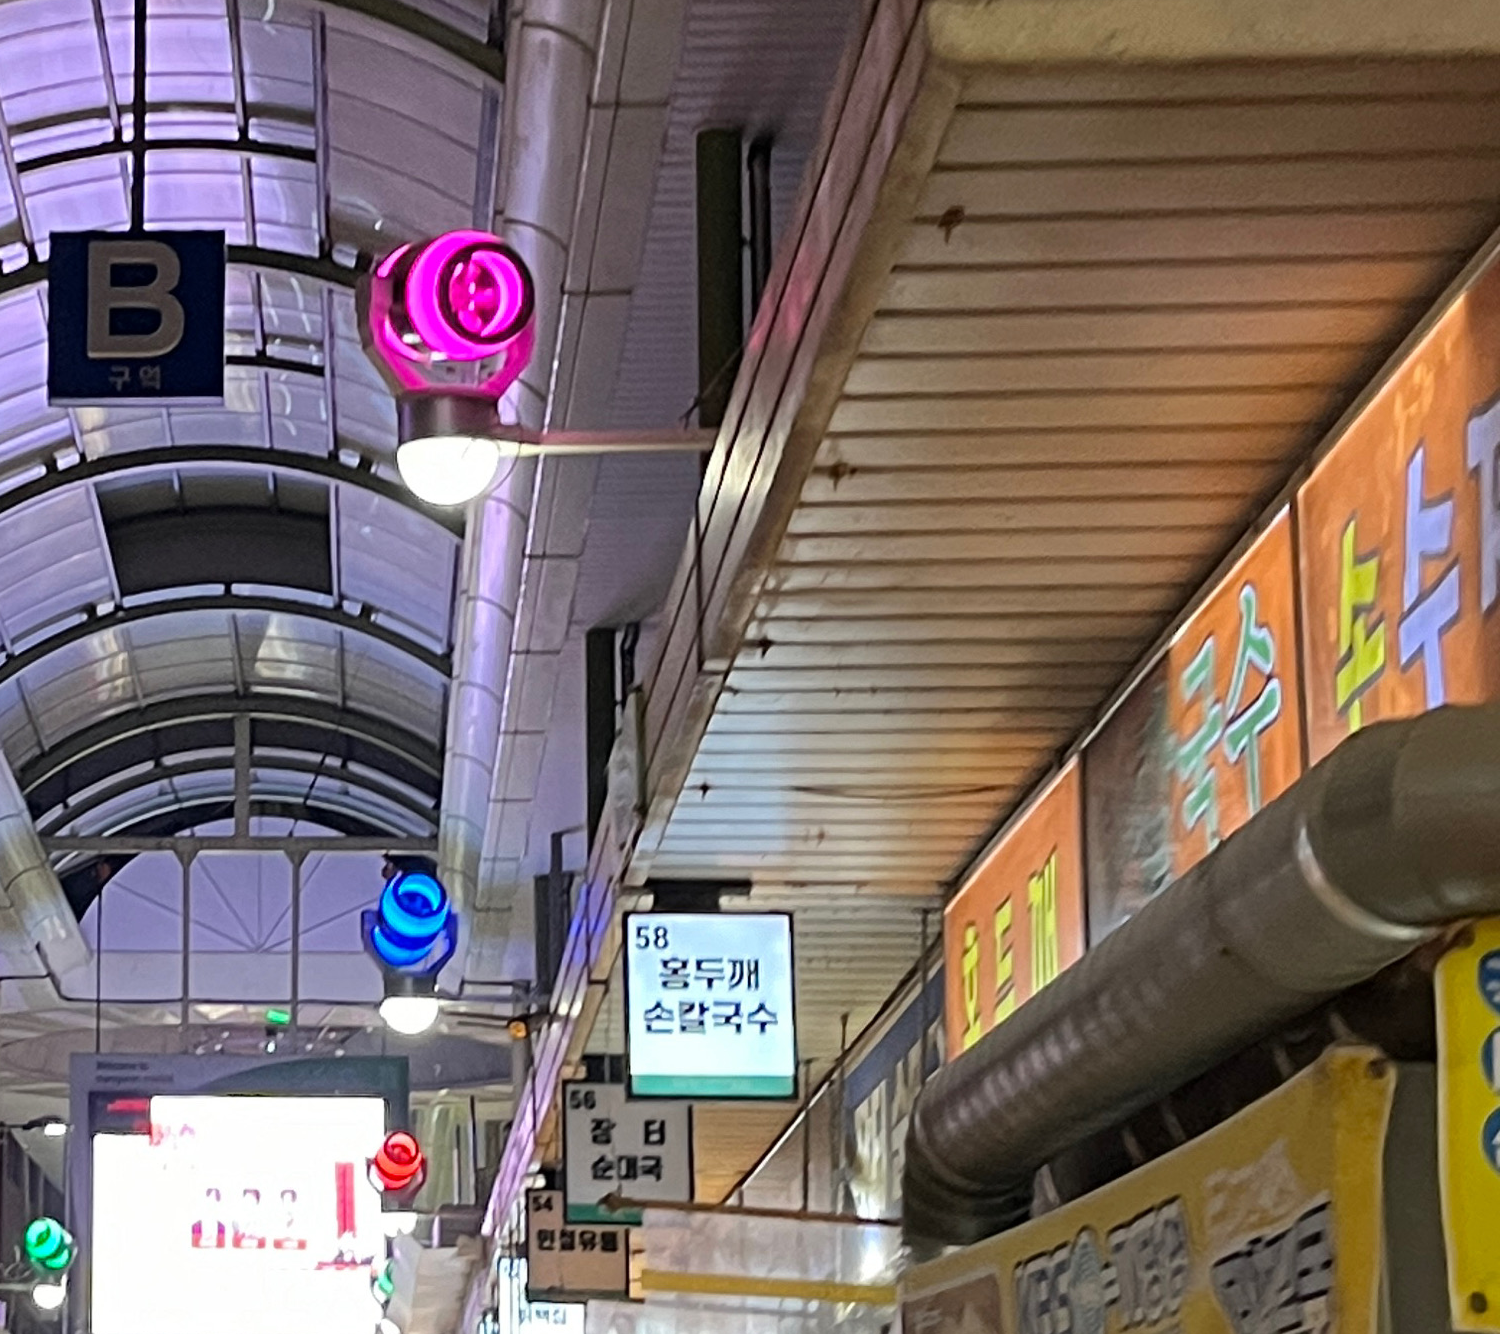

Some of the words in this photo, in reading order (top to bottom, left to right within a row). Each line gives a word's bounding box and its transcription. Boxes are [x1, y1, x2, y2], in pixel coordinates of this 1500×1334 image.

[87, 240, 185, 358] B
[108, 365, 161, 391] 구역
[1174, 582, 1282, 853] 국수
[635, 925, 669, 950] 58
[659, 956, 760, 991] 홍두깨
[643, 999, 779, 1035] 손칼국수
[569, 1089, 597, 1110] 56
